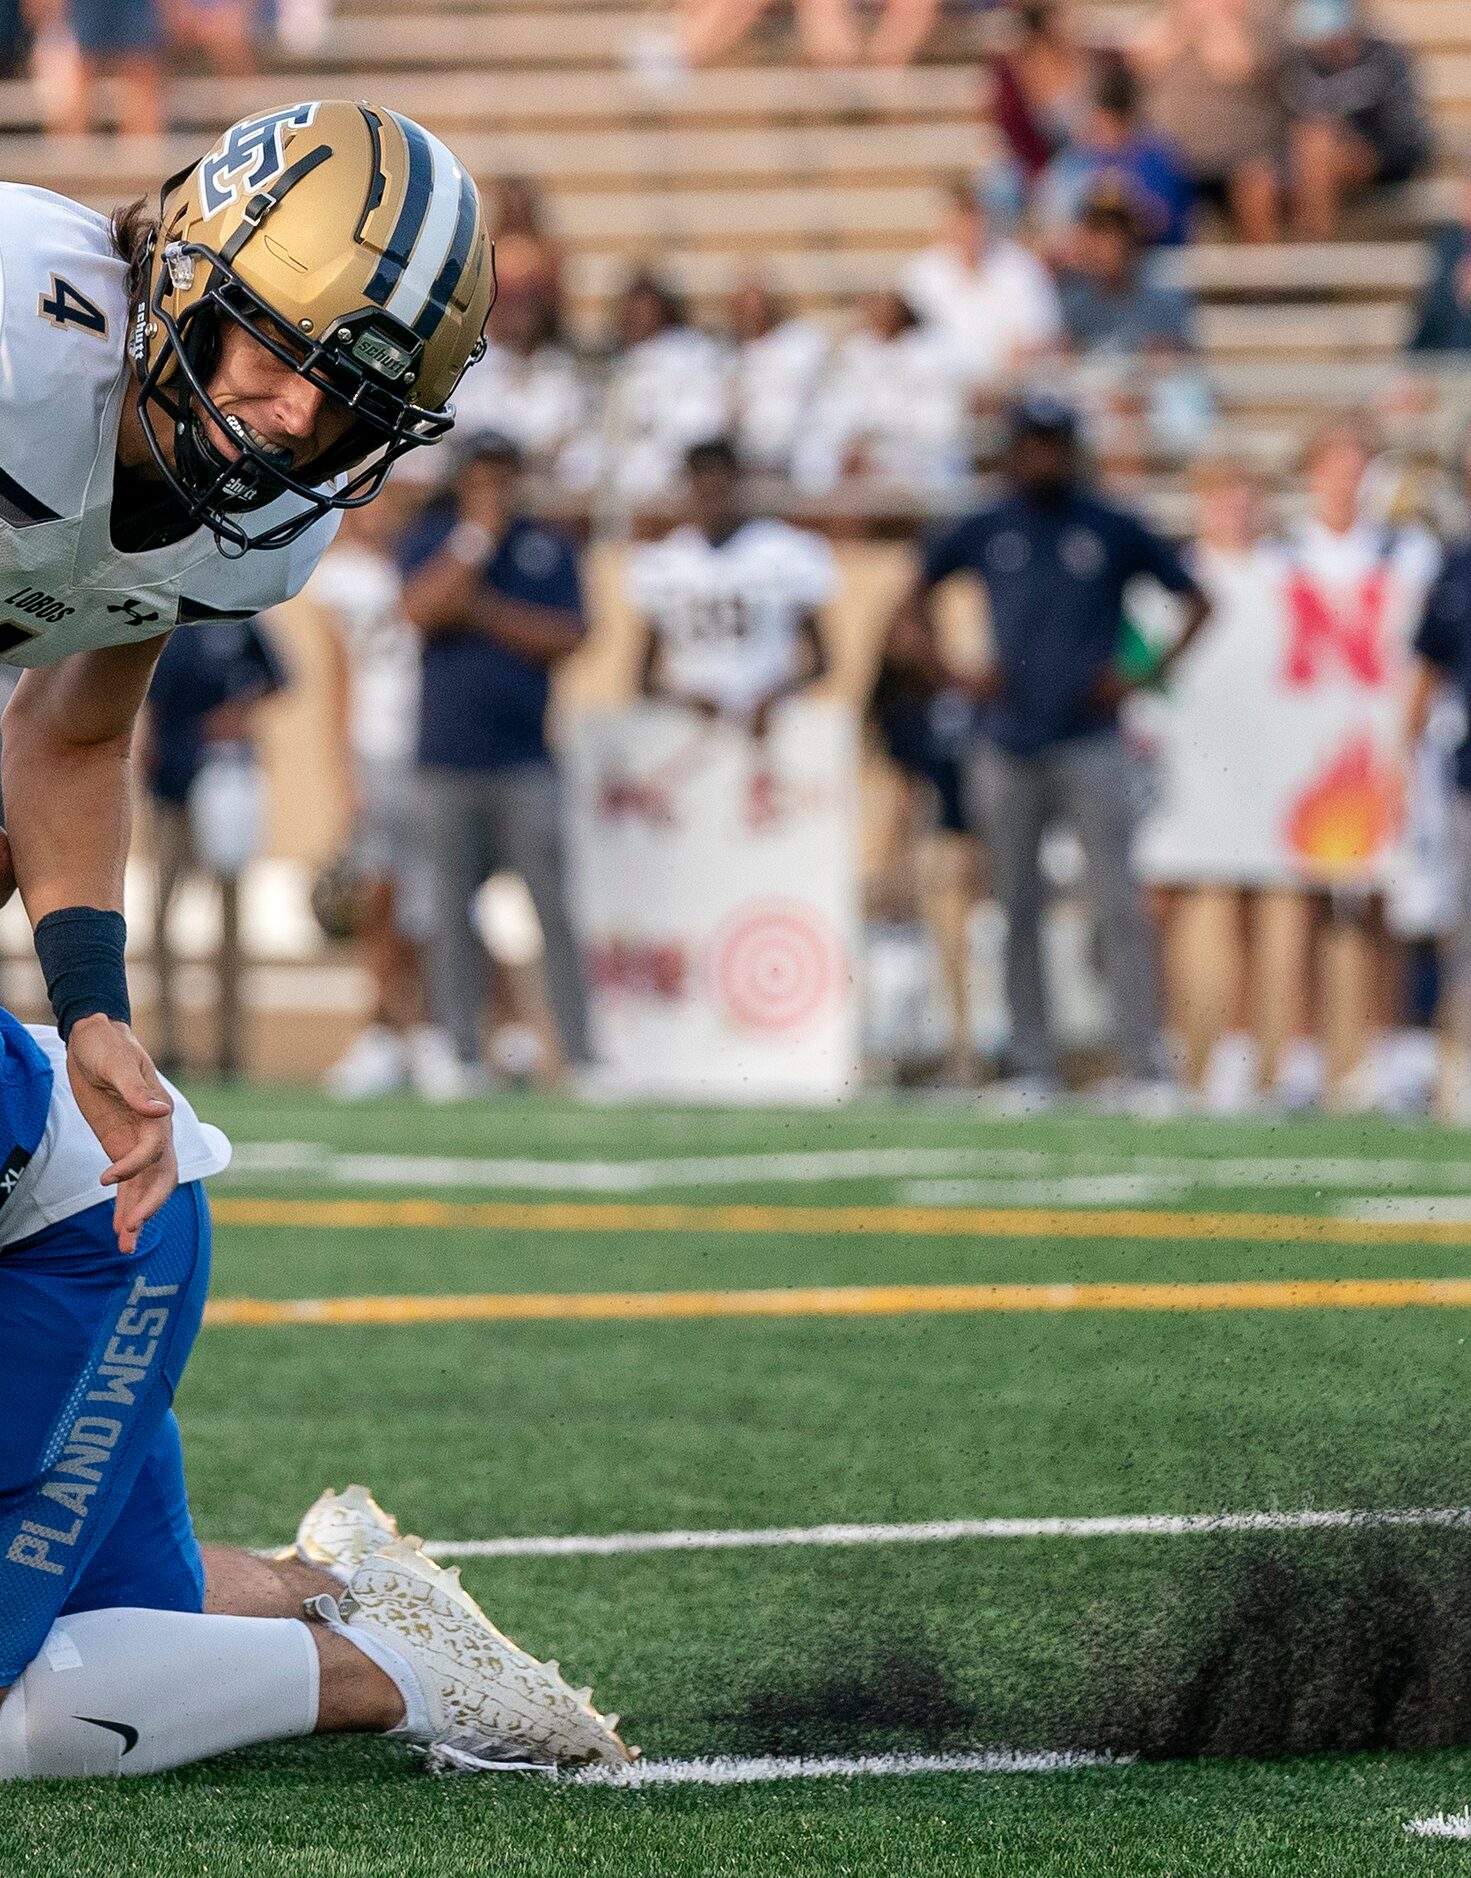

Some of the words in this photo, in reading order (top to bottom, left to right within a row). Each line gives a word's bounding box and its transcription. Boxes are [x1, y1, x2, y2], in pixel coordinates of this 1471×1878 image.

[38, 272, 109, 341] 4
[134, 301, 147, 360] schutt
[357, 340, 405, 374] schutt
[4, 586, 76, 624] LOBOS
[1288, 571, 1388, 688] N
[0, 1166, 25, 1194] XL
[85, 1275, 180, 1407] WEST
